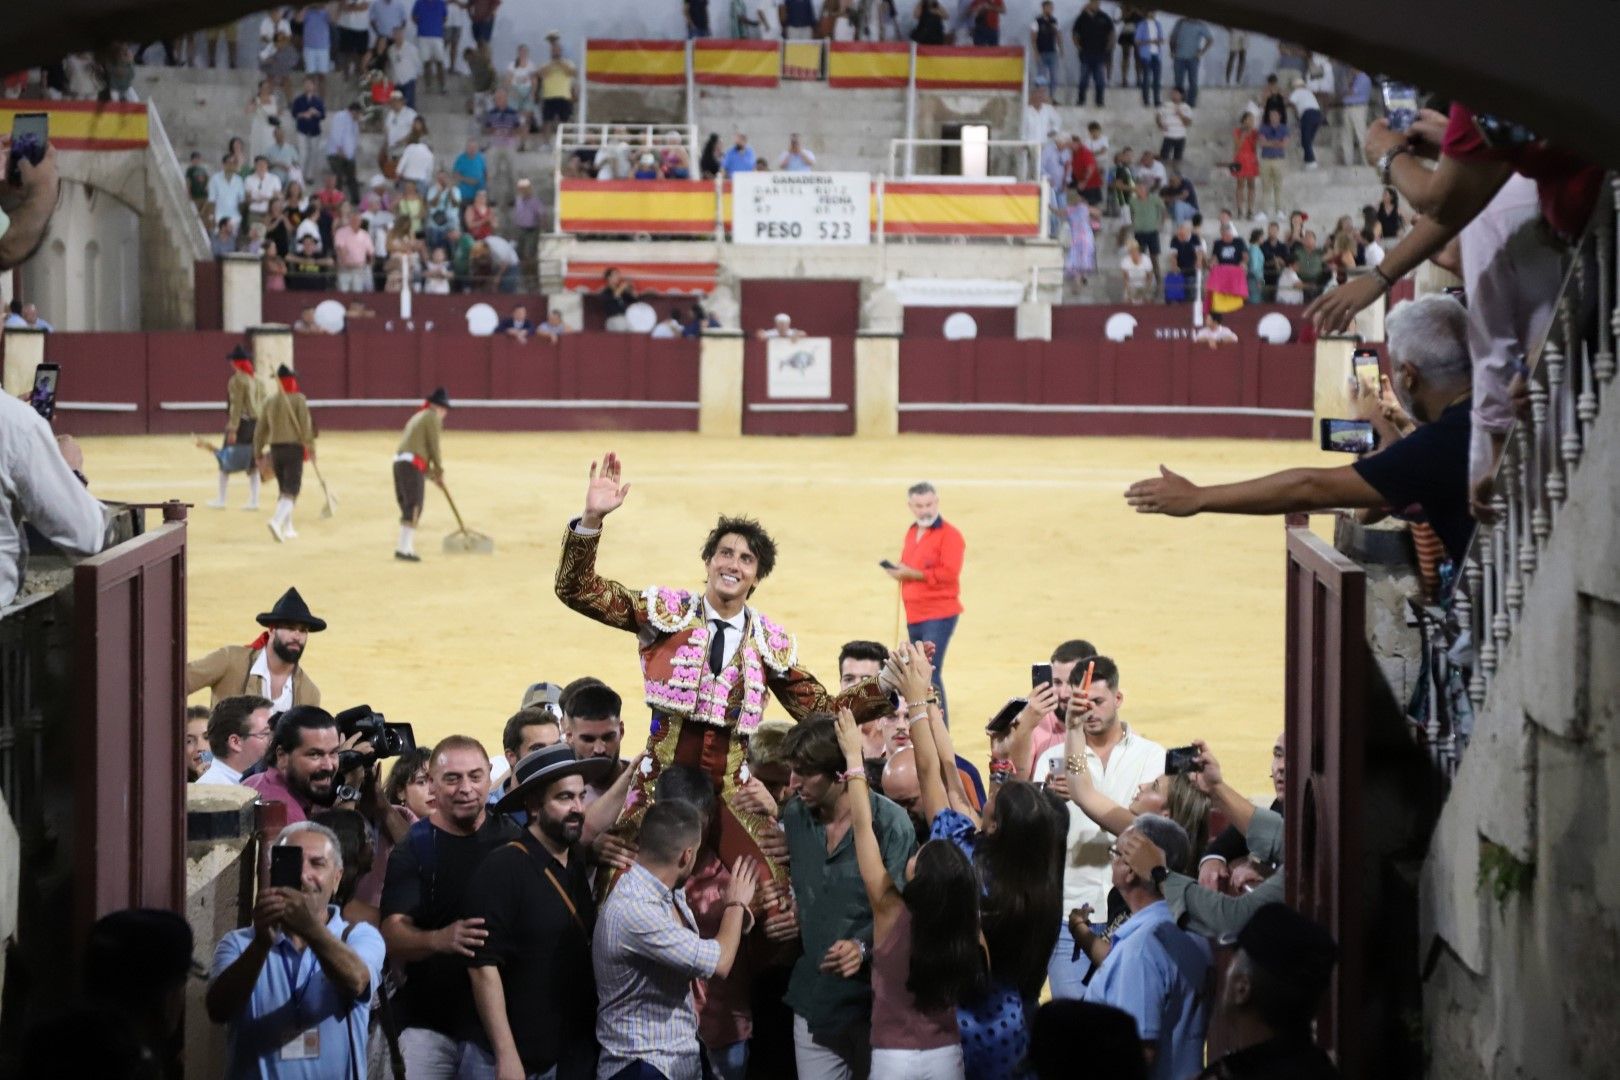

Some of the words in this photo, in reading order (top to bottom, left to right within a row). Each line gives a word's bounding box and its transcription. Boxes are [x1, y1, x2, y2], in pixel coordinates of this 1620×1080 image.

[772, 175, 833, 185] GANADERIA
[756, 221, 802, 239] PESO
[819, 221, 851, 239] 523
